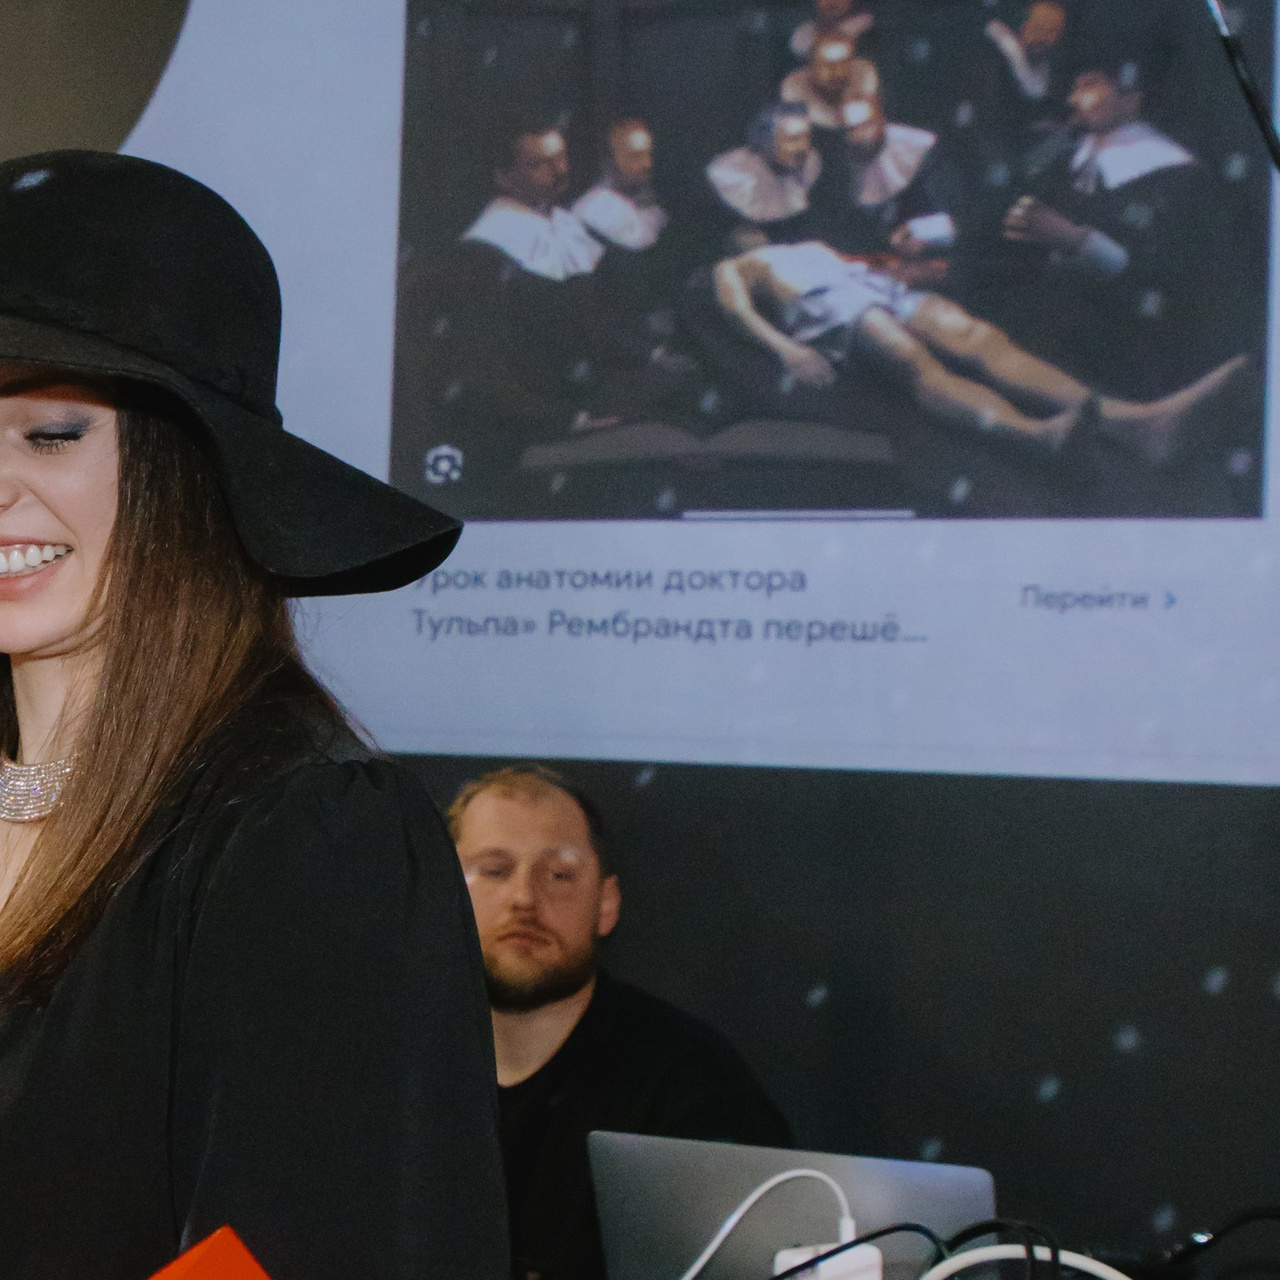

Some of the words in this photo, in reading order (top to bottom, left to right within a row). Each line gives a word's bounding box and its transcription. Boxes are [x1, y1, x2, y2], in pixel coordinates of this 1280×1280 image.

[495, 569, 654, 591] анатомии
[663, 569, 808, 598] доктора
[412, 608, 537, 643] Тульпа»
[548, 609, 754, 646] Рембрандта
